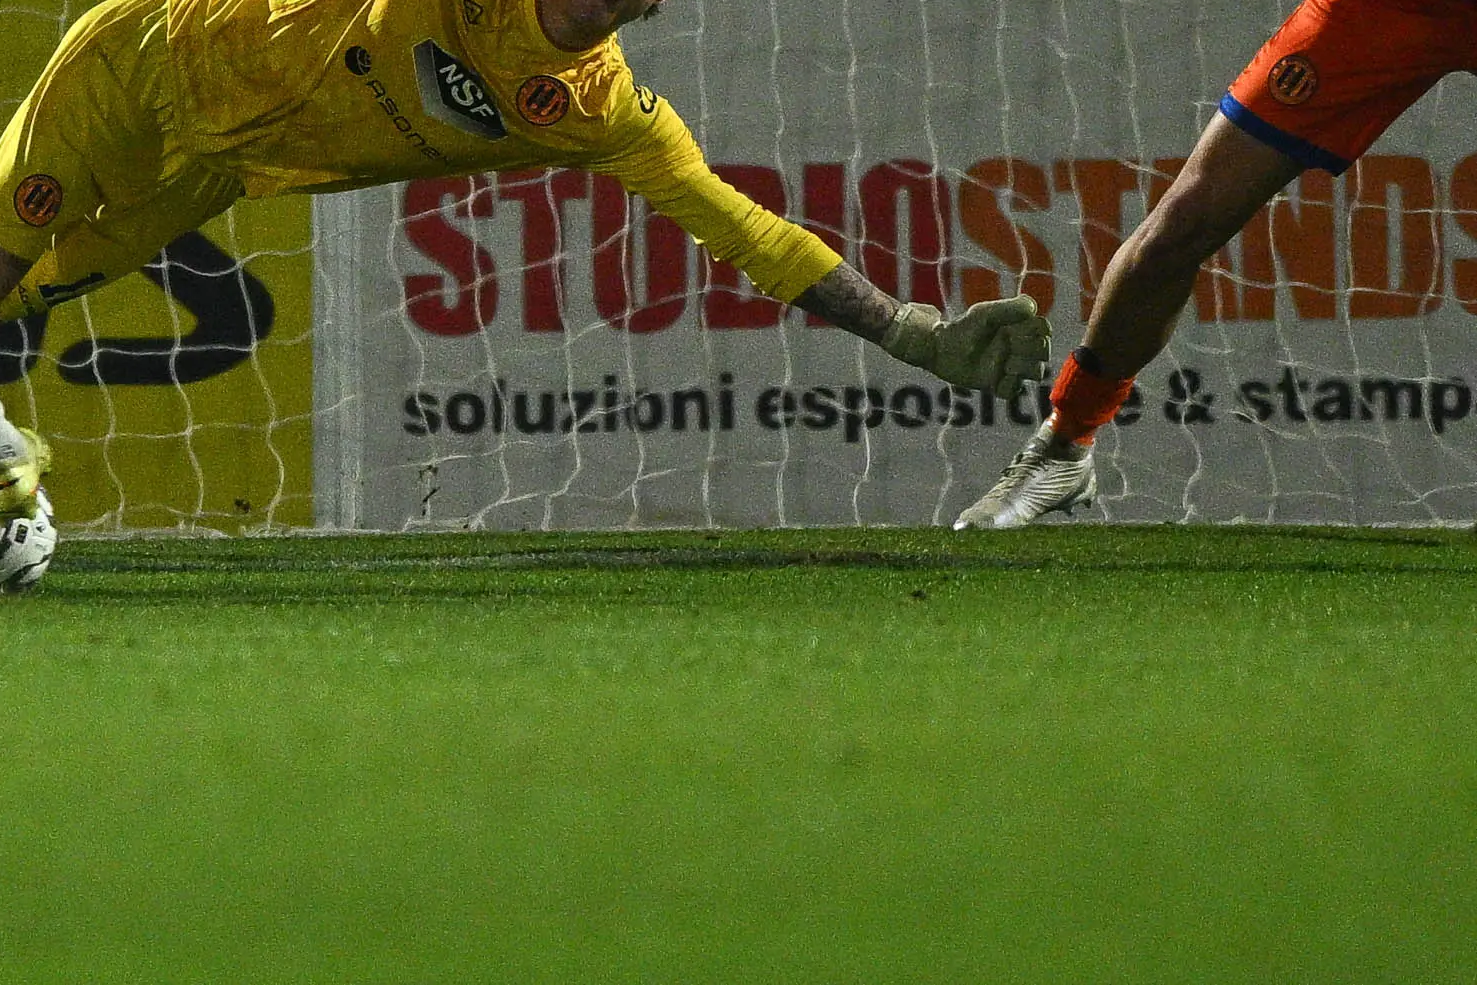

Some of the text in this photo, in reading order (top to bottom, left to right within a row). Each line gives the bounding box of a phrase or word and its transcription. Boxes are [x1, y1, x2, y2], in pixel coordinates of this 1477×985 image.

[439, 62, 494, 117] NSF
[403, 373, 735, 435] soluzioni
[1164, 368, 1215, 427] &
